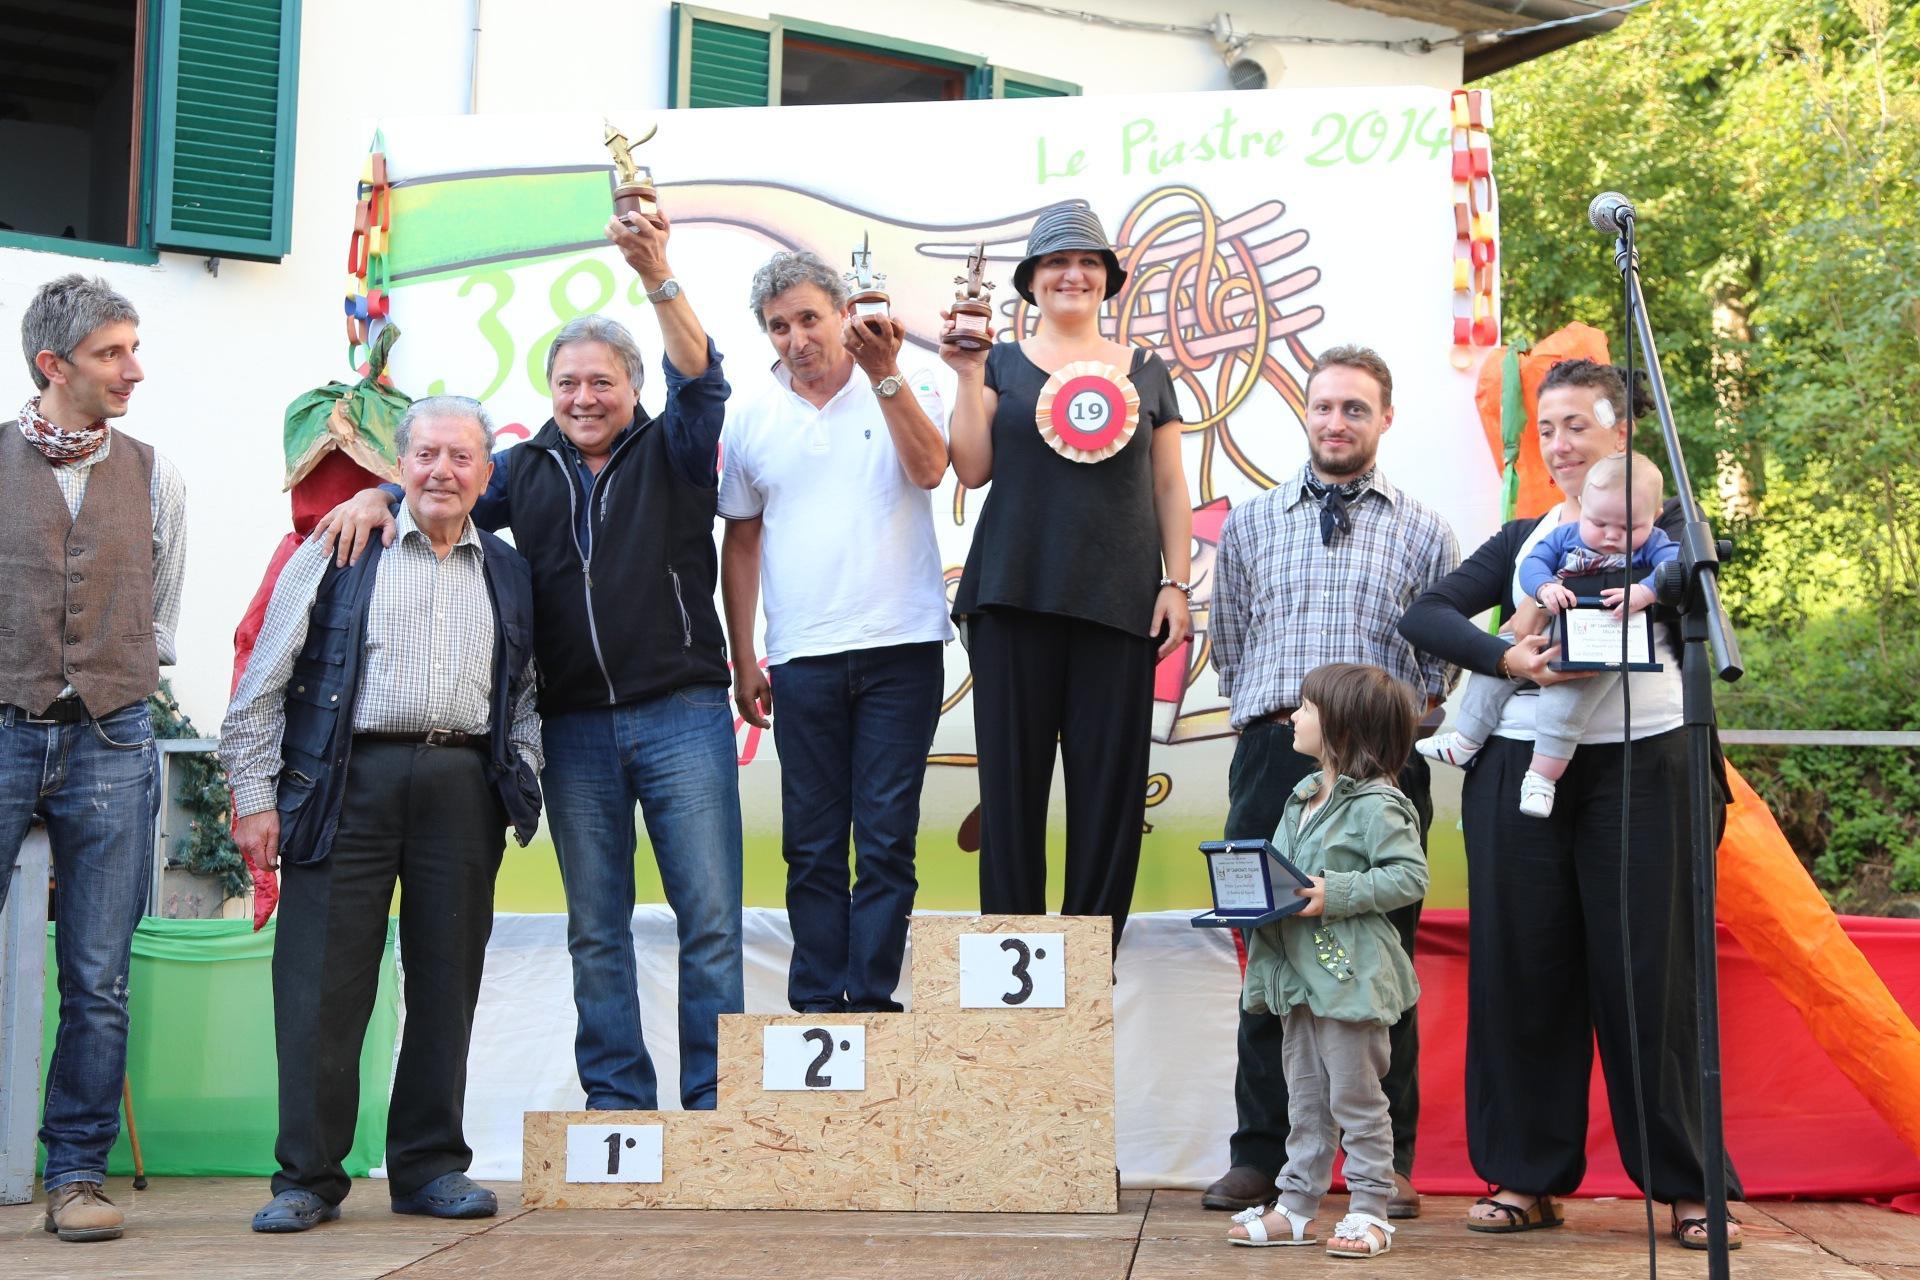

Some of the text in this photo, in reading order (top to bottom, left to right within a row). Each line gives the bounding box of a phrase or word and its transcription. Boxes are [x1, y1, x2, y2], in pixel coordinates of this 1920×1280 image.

[1036, 107, 1451, 185] Le Piastre 2014
[1074, 402, 1104, 420] 19
[1000, 938, 1046, 1005] 3°
[802, 1028, 850, 1087] 2°
[603, 1132, 637, 1175] 1°
